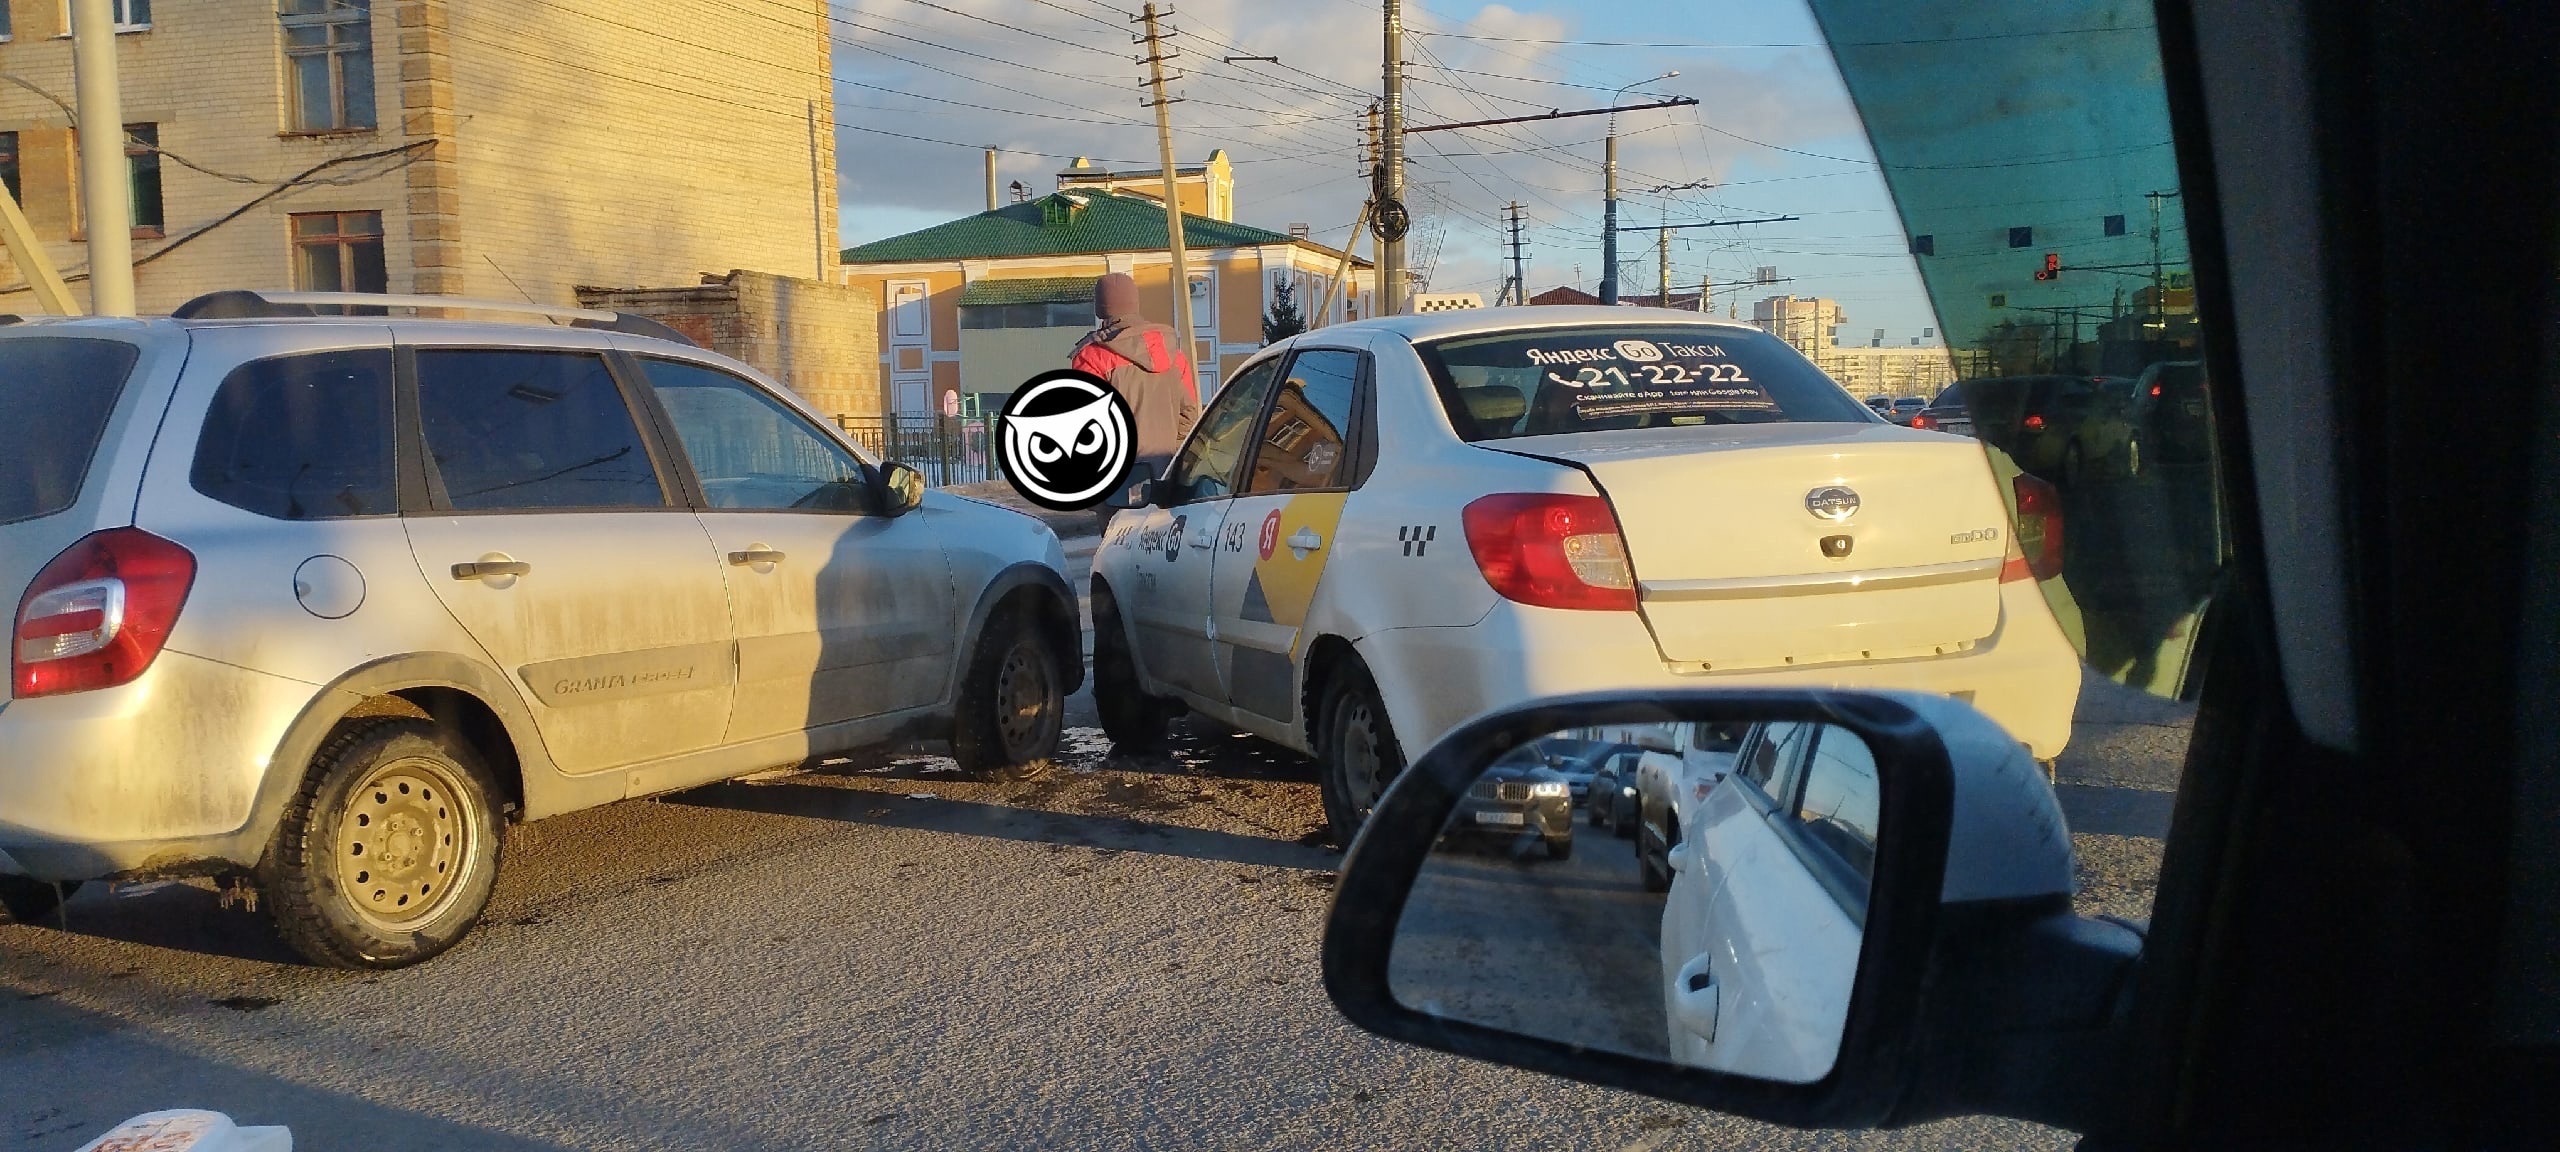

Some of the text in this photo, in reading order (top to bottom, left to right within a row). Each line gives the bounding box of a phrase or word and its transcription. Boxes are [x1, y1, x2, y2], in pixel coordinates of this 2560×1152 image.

[1526, 342, 1726, 365] Яндекс Go Такси
[1578, 364, 1750, 387] 21-22-22
[1576, 393, 1637, 401] Скачивайте
[1709, 387, 1740, 396] Google
[1812, 497, 1857, 507] DATSUN
[1224, 522, 1246, 553] 143
[1262, 517, 1277, 549] Я
[554, 675, 625, 695] GRANTA
